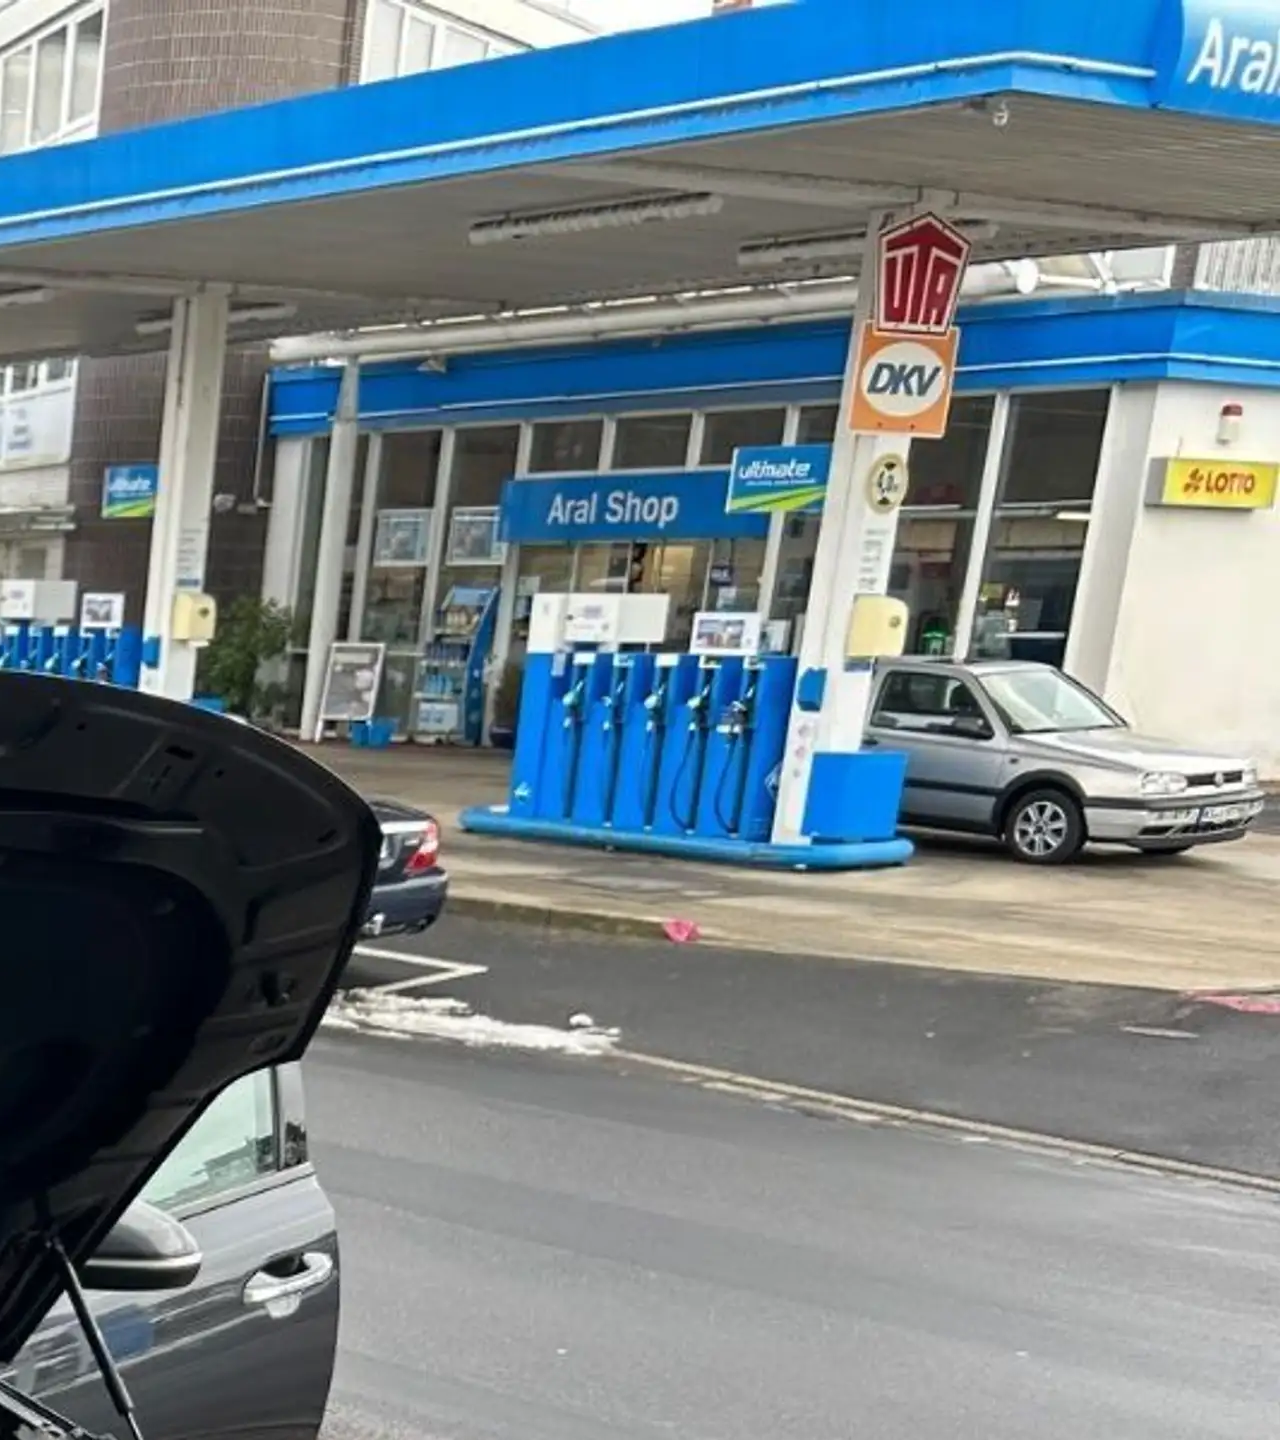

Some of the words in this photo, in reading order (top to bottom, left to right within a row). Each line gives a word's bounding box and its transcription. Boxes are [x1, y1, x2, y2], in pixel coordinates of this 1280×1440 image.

[1185, 17, 1280, 95] Aral
[867, 361, 942, 398] DKV
[739, 457, 812, 480] ultimate
[1206, 470, 1256, 495] LOTTO
[546, 493, 596, 526] Aral
[604, 490, 680, 529] Shop
